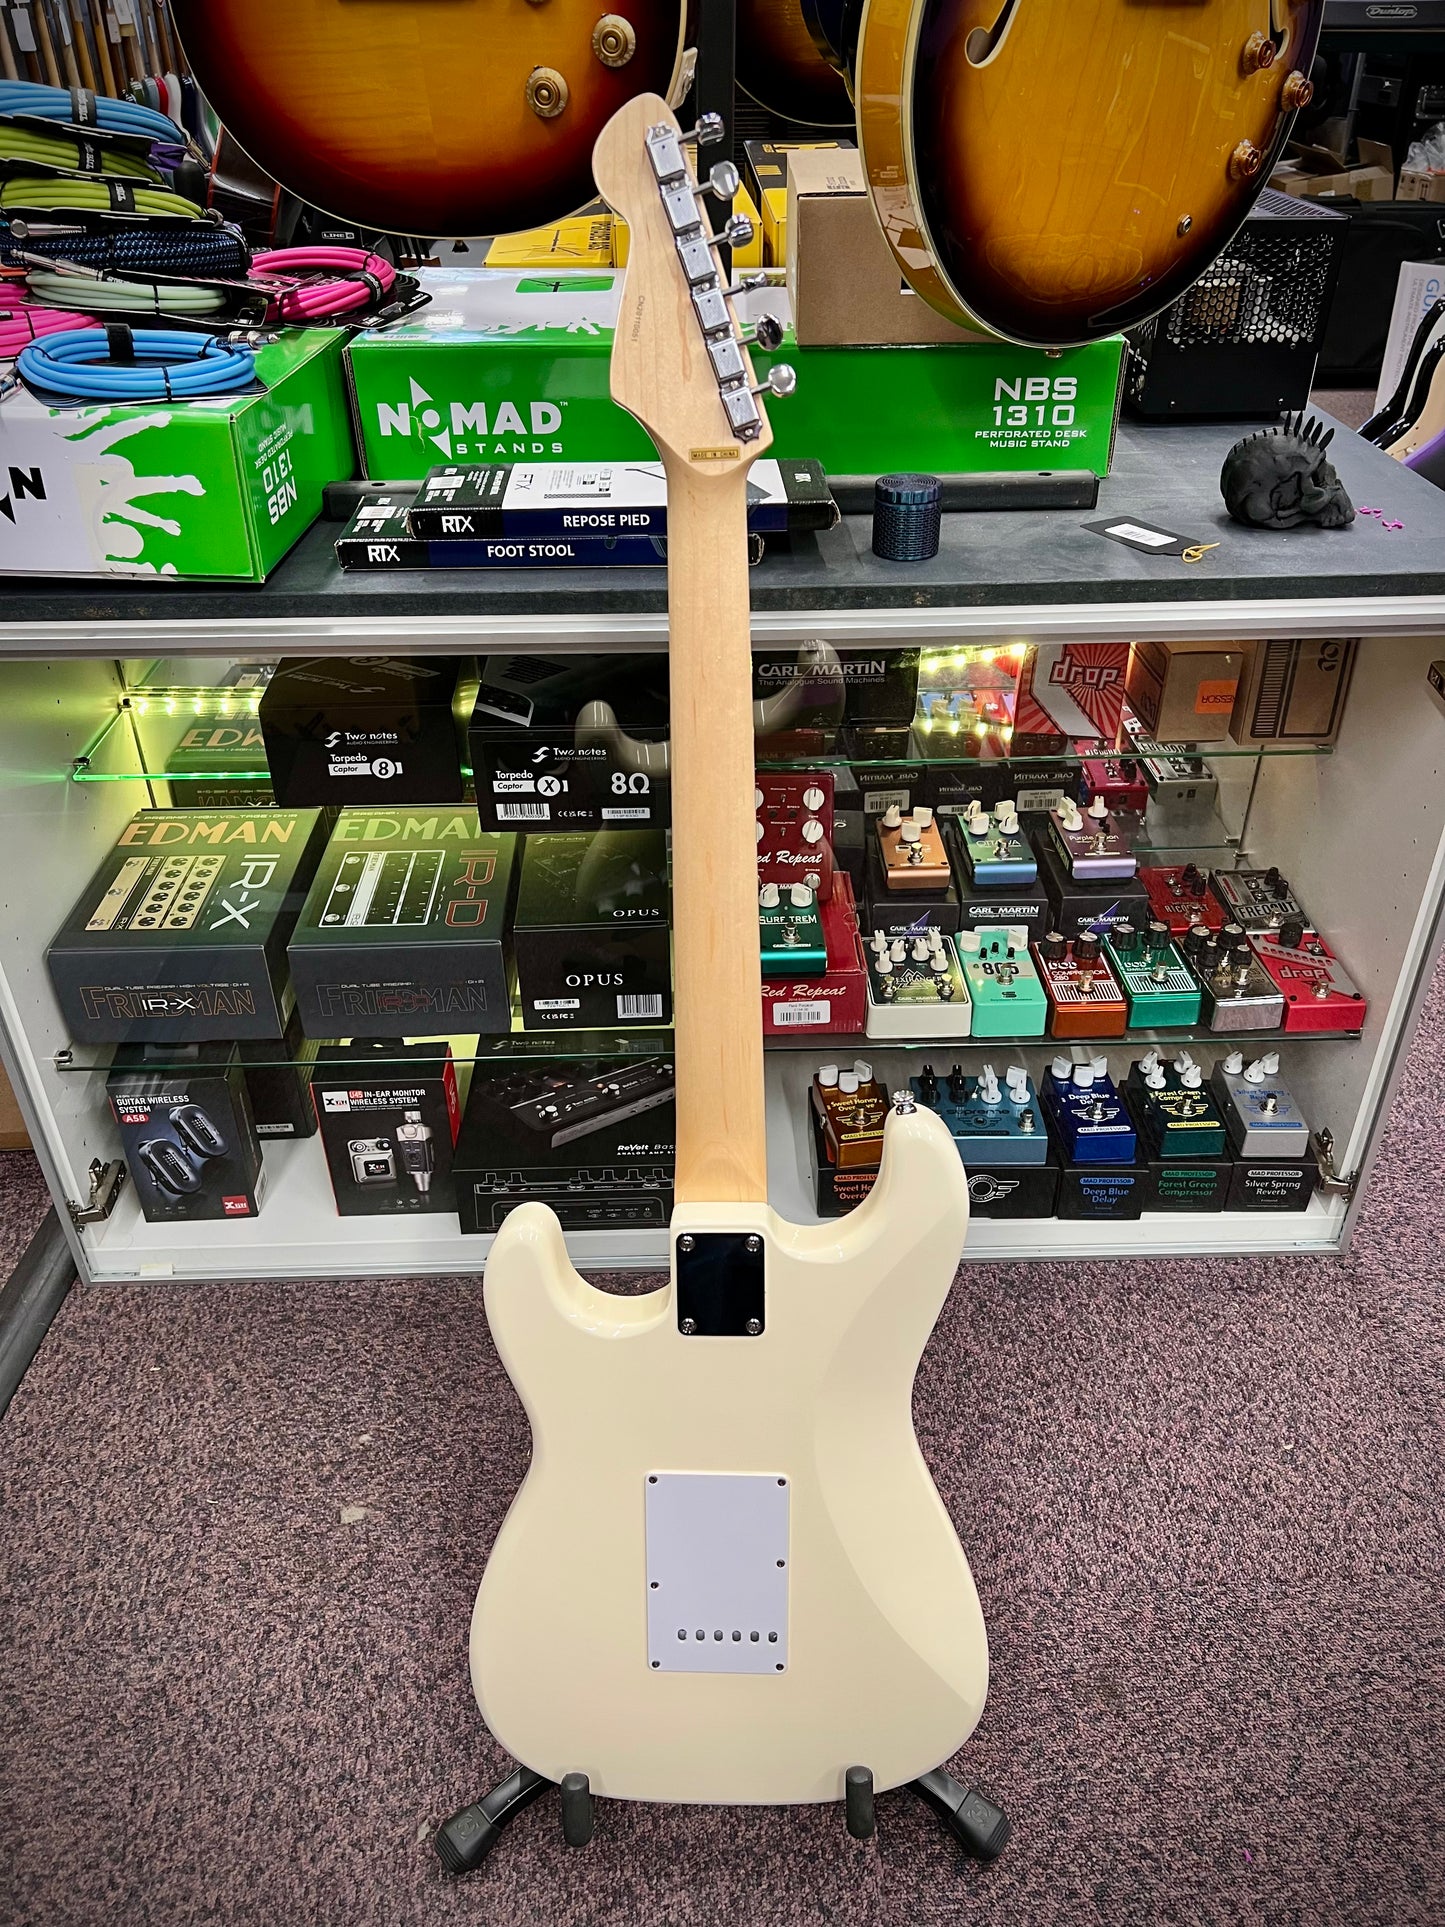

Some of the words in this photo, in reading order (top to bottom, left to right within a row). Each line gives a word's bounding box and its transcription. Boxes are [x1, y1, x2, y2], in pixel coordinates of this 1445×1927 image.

[1370, 8, 1414, 16] Dunlop
[995, 377, 1078, 401] NBS
[377, 401, 562, 436] NOMAD
[993, 405, 1076, 426] 1310
[974, 430, 1050, 439] PERFORATED
[1054, 429, 1087, 438] DESK
[457, 441, 563, 454] STANDS
[990, 439, 1027, 448] MUSIC
[1031, 438, 1070, 447] STAND
[262, 448, 293, 494] 1310
[267, 475, 298, 526] NBS
[441, 515, 475, 533] RTX
[563, 514, 616, 528] REPOSE
[619, 514, 650, 527] PIED
[367, 545, 401, 562] RTX
[487, 545, 525, 558] FOOT
[529, 544, 575, 557] STOOL
[758, 663, 803, 677] CARL
[812, 661, 886, 676] MARTIN
[1052, 656, 1119, 691] drop
[775, 679, 815, 687] Analogue
[845, 676, 885, 684] Machines
[345, 732, 367, 740] Two
[369, 732, 398, 740] notes
[553, 747, 575, 756] Two
[578, 747, 607, 756] notes
[329, 752, 368, 764] Torpedo
[332, 765, 359, 774] Captor
[378, 761, 389, 776] 8
[495, 770, 533, 781] Torpedo
[497, 782, 524, 791] Captor
[543, 779, 555, 793] X
[611, 772, 650, 795] 8Ω
[776, 850, 823, 867] Repeat
[210, 853, 281, 931] IR-X
[444, 850, 498, 928] IR-D
[612, 908, 660, 918] OPUS
[969, 906, 994, 914] CARL
[998, 906, 1039, 914] MARTIN
[759, 915, 786, 924] SURF
[789, 914, 817, 924] TREM
[1280, 965, 1325, 979] drop
[565, 973, 624, 987] OPUS
[761, 985, 787, 998] Red
[792, 984, 847, 999] Repeat
[80, 986, 256, 1020] FRIEDMAN
[141, 997, 196, 1011] IR-X
[364, 1090, 391, 1098] IN-EAR
[392, 1089, 426, 1097] MONITOR
[116, 1097, 146, 1106] GUITAR
[146, 1095, 190, 1105] WIRELESS
[350, 1097, 388, 1106] WIRELESS
[389, 1096, 418, 1104] SYSTEM
[831, 1099, 854, 1108] Sweet
[854, 1097, 878, 1106] Honey
[118, 1105, 152, 1114] SYSTEM
[126, 1114, 146, 1123] A58
[833, 1184, 860, 1193] Sweet
[1158, 1180, 1186, 1188] Forest
[1245, 1180, 1270, 1188] Silver
[1271, 1180, 1301, 1190] Spring
[1082, 1187, 1107, 1196] Deep
[1108, 1187, 1130, 1195] Blue
[1158, 1188, 1213, 1197] Compressor
[1092, 1195, 1118, 1204] Delay
